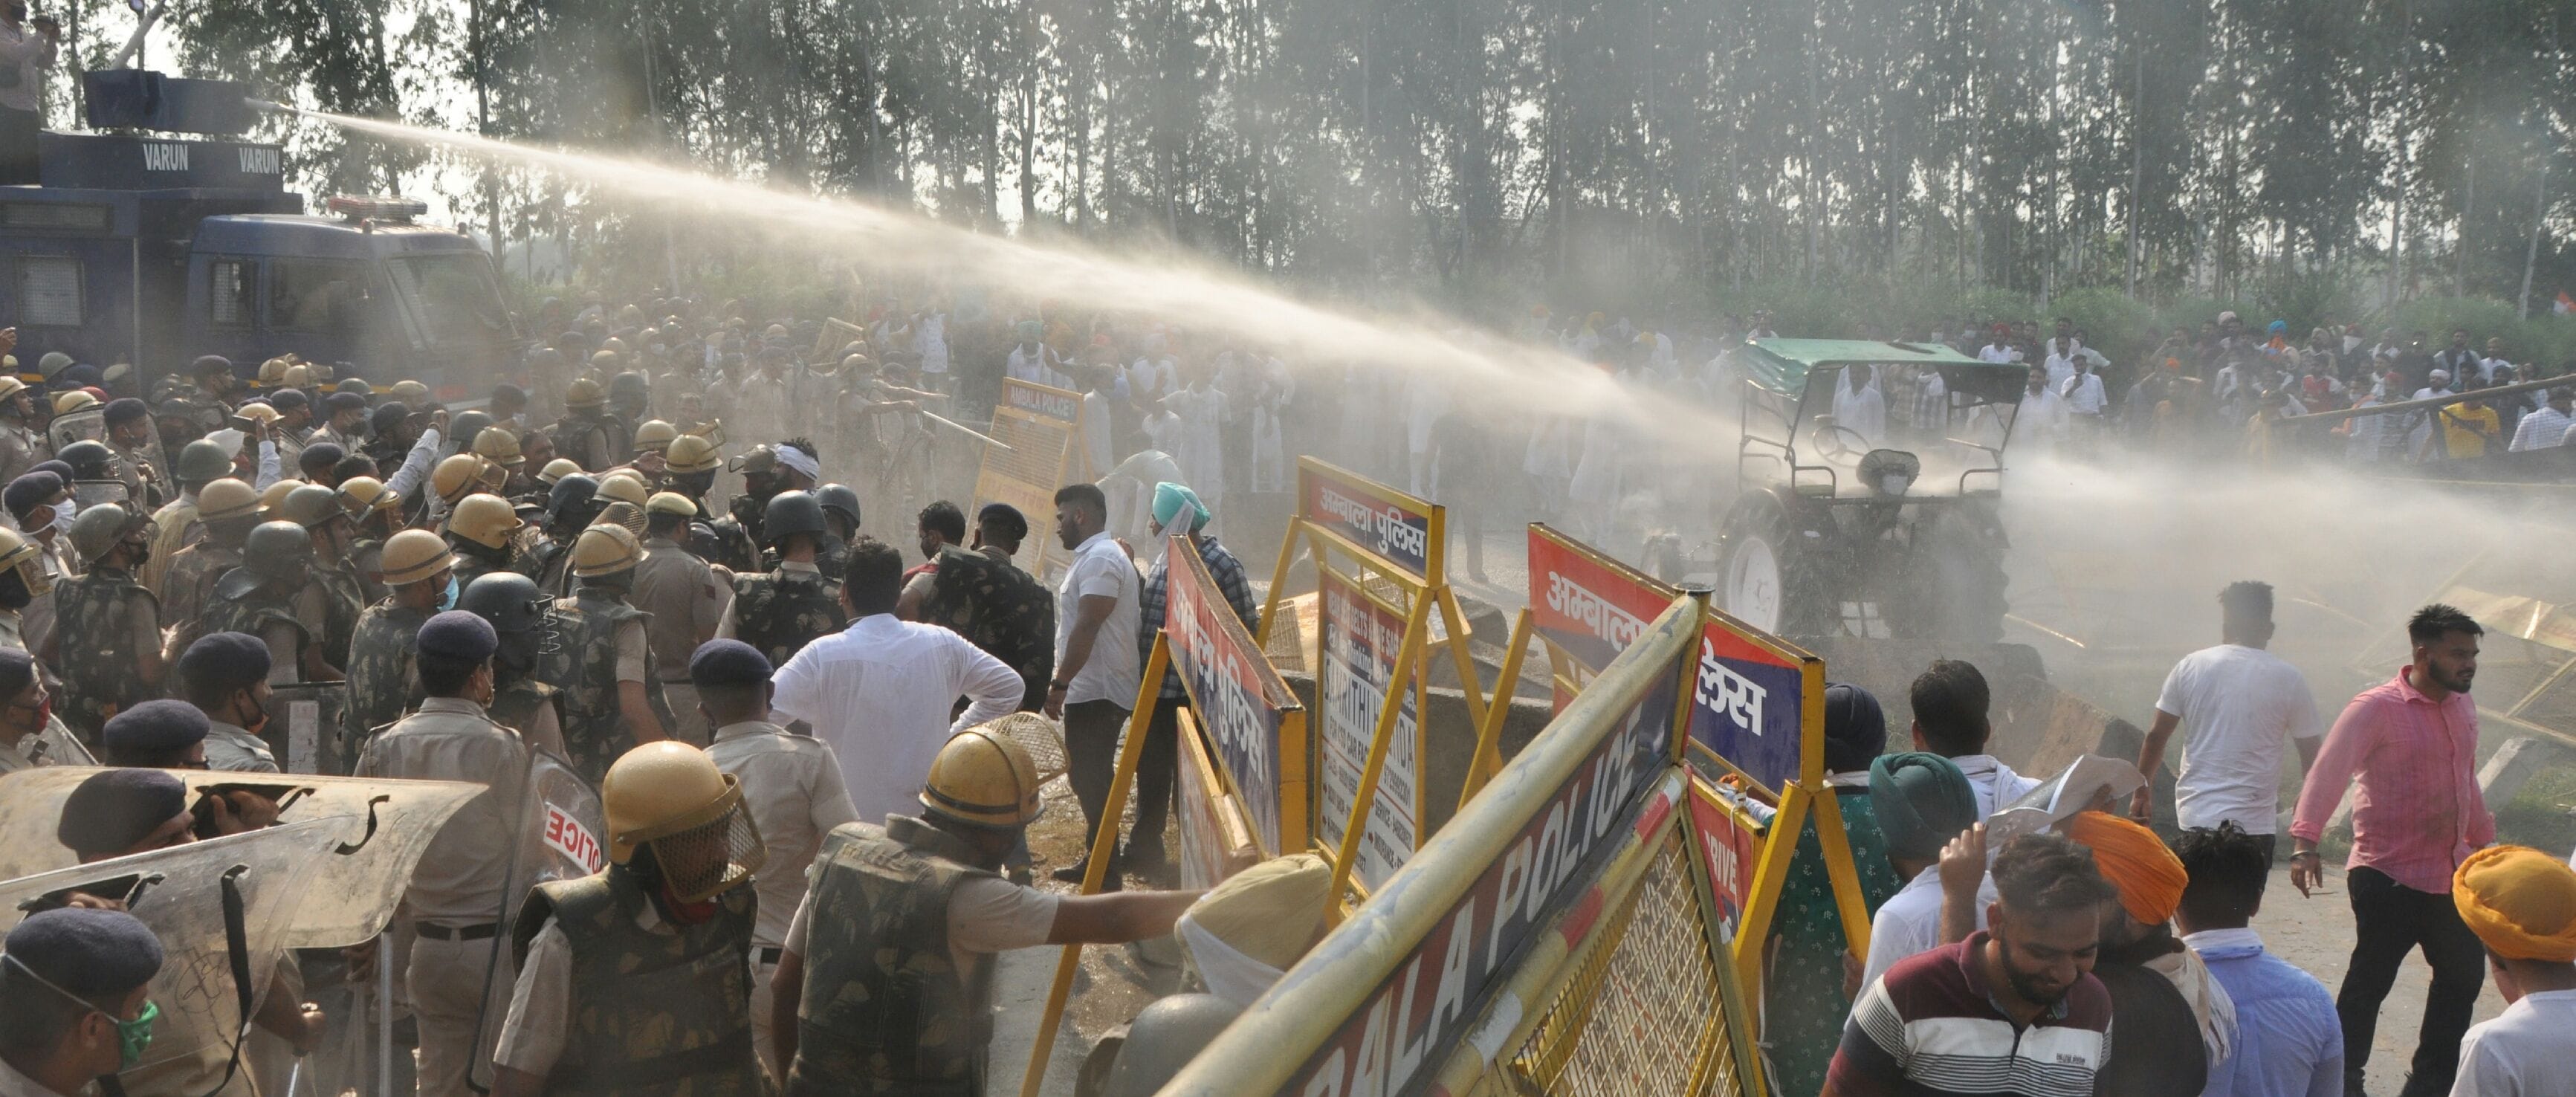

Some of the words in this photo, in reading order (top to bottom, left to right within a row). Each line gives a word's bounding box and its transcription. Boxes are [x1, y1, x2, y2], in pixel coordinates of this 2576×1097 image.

[143, 143, 188, 171] VARUN
[239, 147, 279, 174] VARUN
[1320, 486, 1373, 532] अम्बाला
[1375, 506, 1425, 558] पुलिस
[1217, 651, 1263, 783] पुलिस
[546, 810, 601, 875] OLICE
[1486, 701, 1643, 976] POLICE
